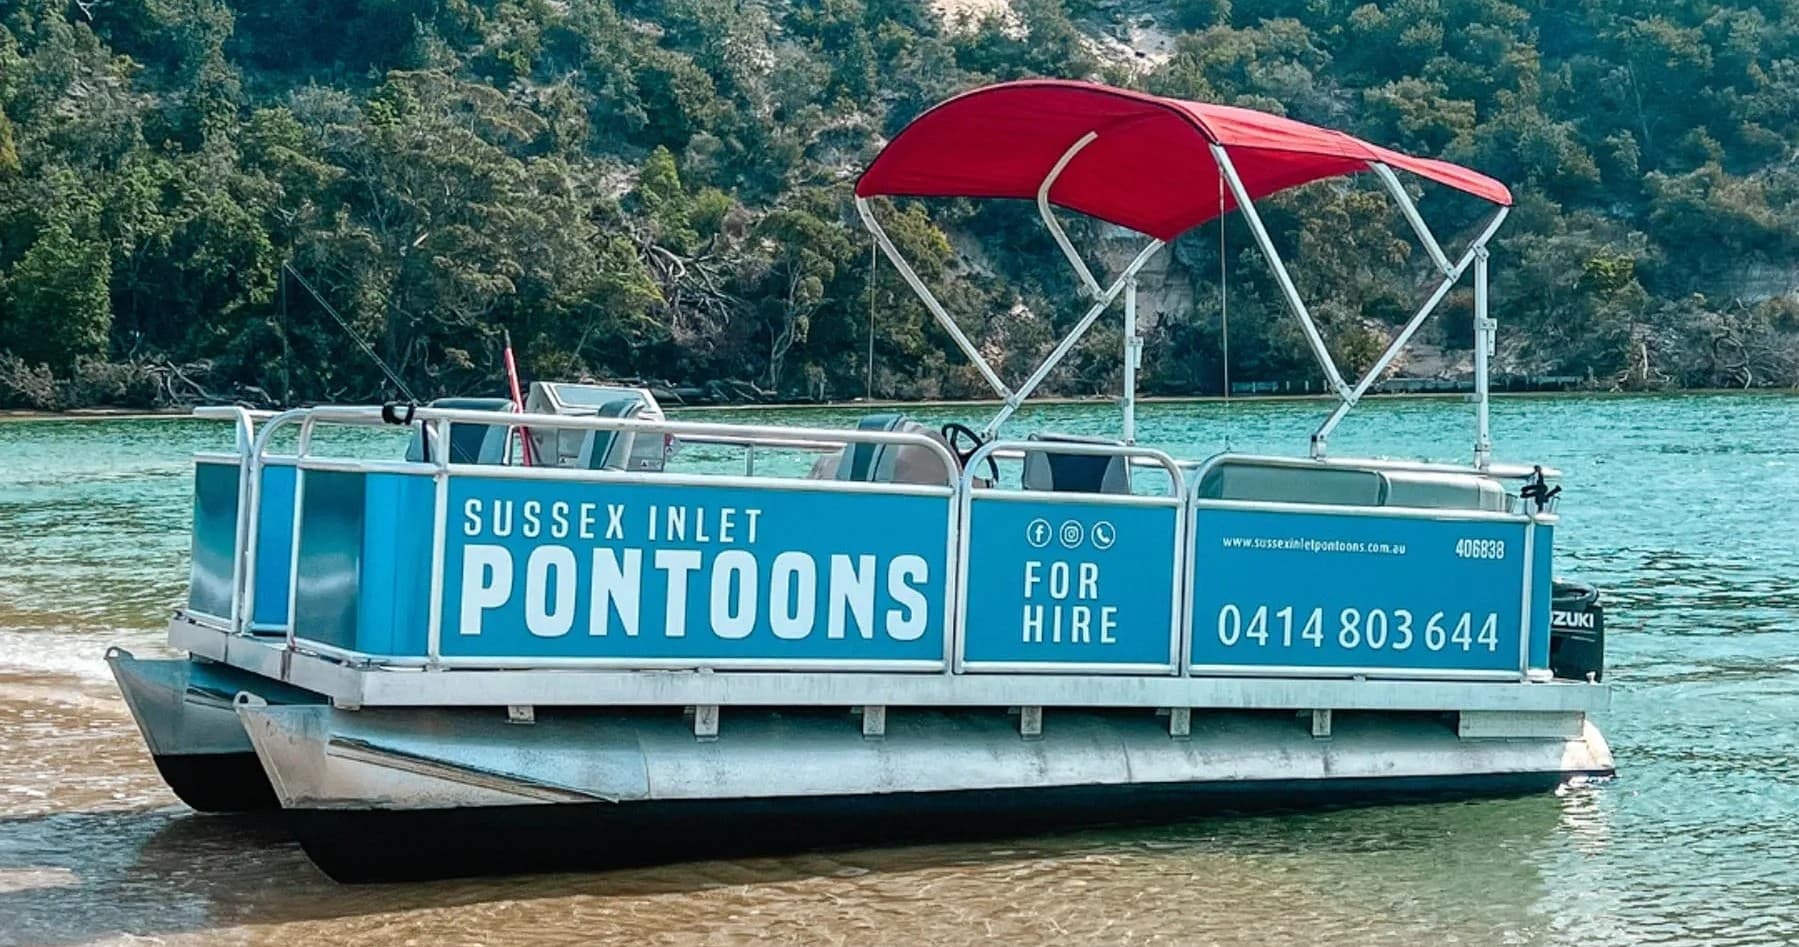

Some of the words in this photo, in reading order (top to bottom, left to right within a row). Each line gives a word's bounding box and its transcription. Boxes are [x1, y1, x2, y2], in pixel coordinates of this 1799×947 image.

[463, 498, 626, 541] SUSSEX
[647, 504, 763, 545] INLET
[1222, 535, 1407, 555] www.sussexinletpontoons.com.au
[1455, 538, 1505, 560] 406838
[459, 543, 930, 642] PONTOONS
[1023, 560, 1099, 600] FOR
[1022, 604, 1118, 644] HIRE
[1217, 603, 1325, 649] 0414
[1337, 607, 1414, 651] 803
[1424, 611, 1500, 652] 644
[1551, 610, 1595, 628] ZUKI
